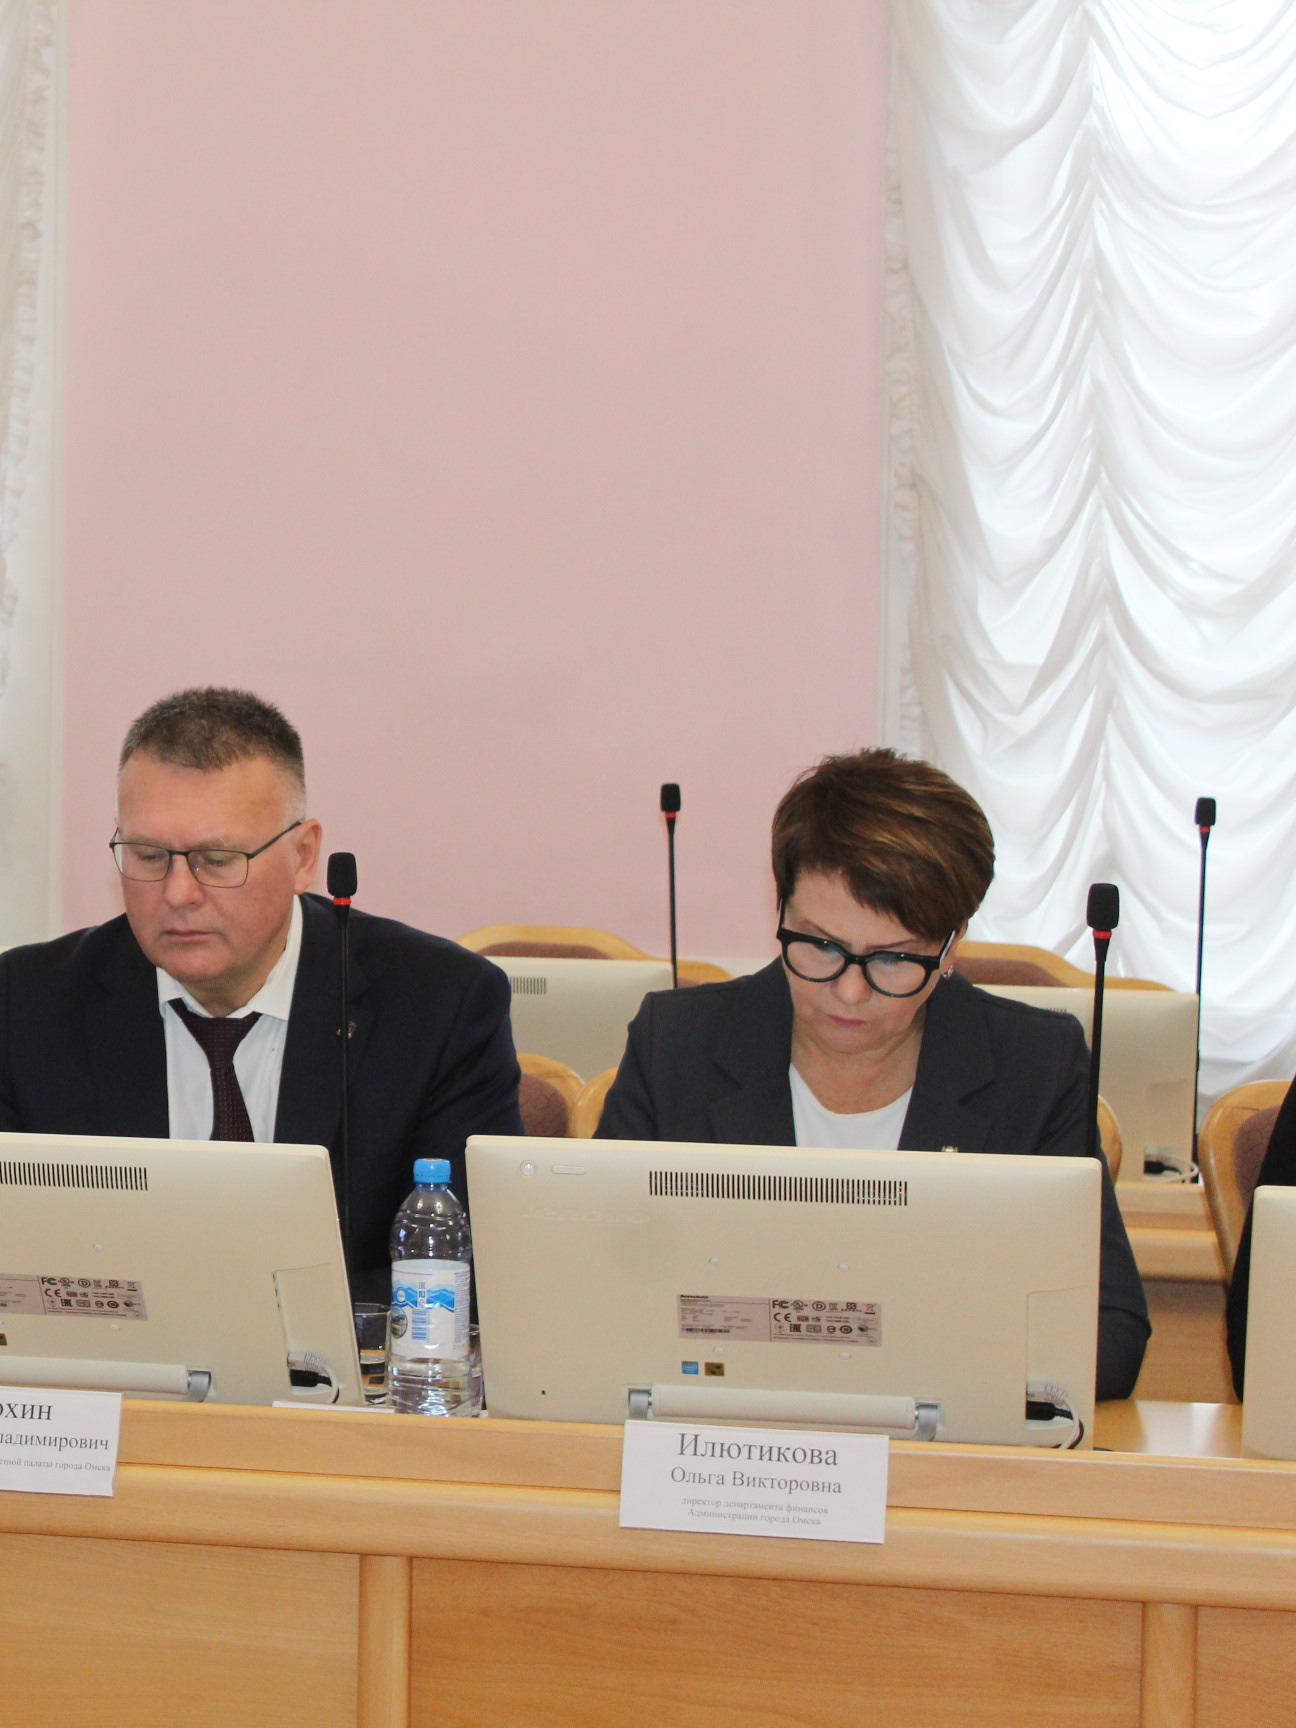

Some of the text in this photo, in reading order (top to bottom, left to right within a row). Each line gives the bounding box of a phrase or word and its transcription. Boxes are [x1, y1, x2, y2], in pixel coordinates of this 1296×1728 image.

[676, 1432, 838, 1466] Илютикова
[24, 1458, 53, 1470] палаты
[54, 1461, 83, 1472] города
[84, 1462, 111, 1472] Омска
[670, 1466, 842, 1495] Ольга Викторовна
[681, 1497, 829, 1515] директор департамента финансов
[687, 1508, 822, 1526] Администрации города Омска
